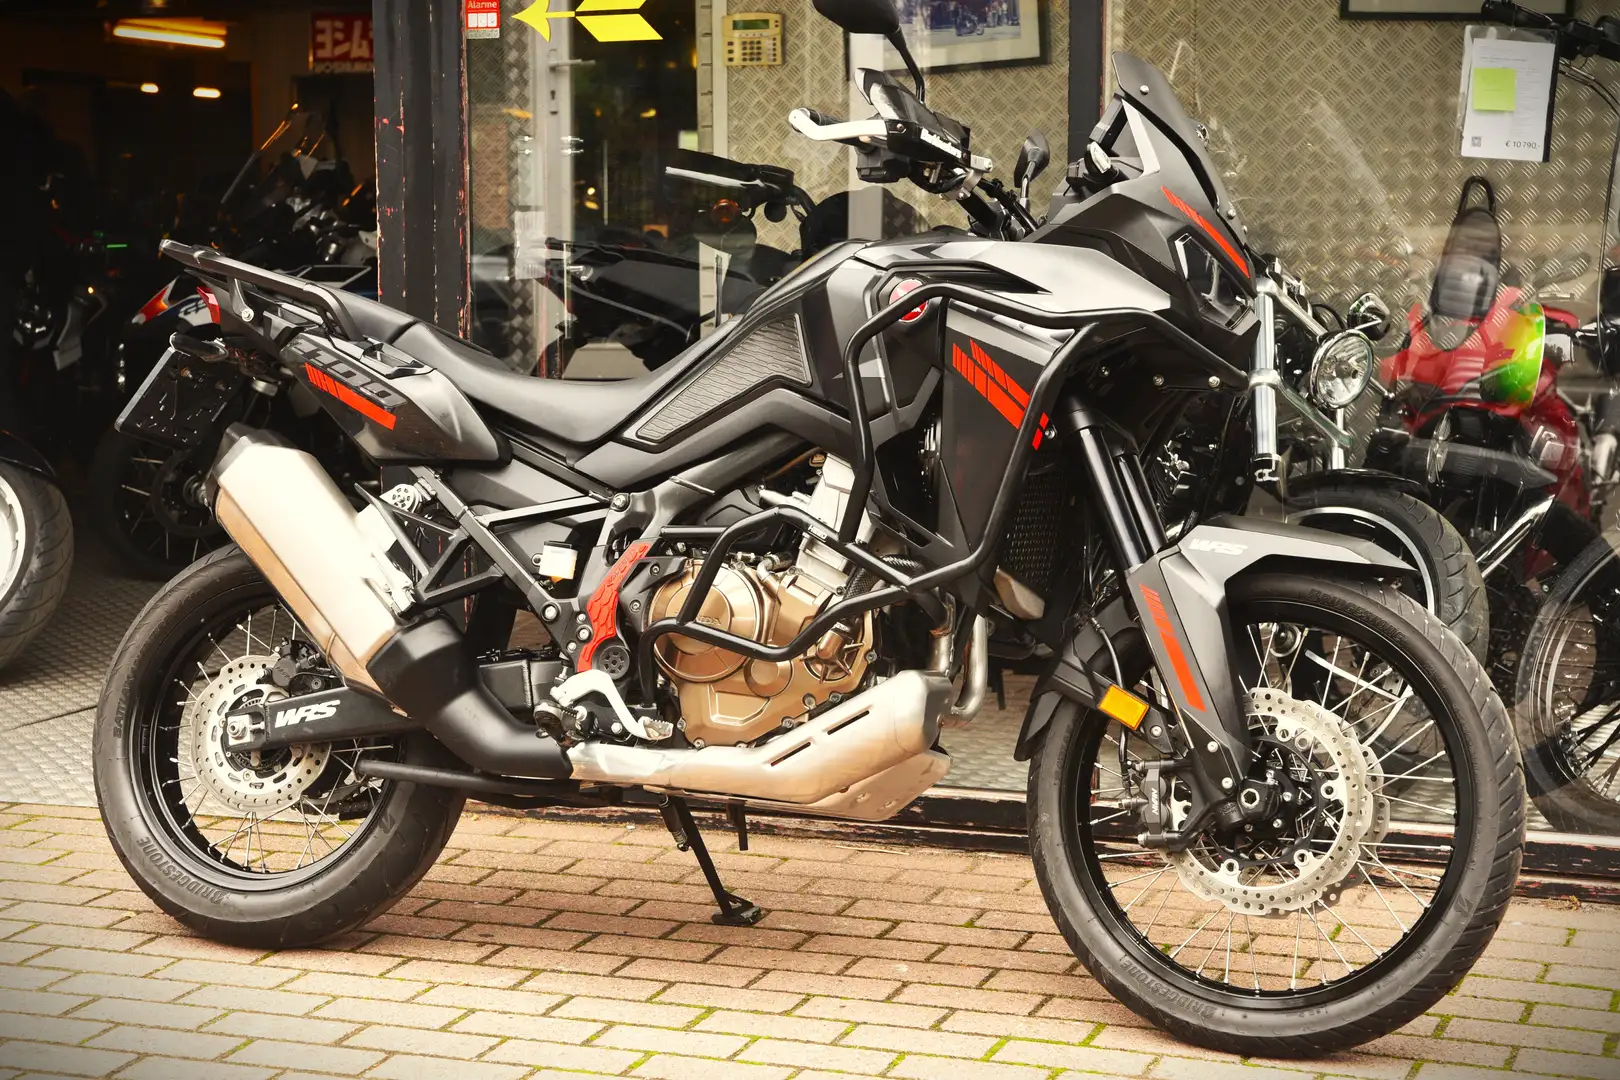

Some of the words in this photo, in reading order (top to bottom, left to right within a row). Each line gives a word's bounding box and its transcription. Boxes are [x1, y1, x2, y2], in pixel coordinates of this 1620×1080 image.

[468, 1, 497, 9] Alarme
[316, 20, 373, 58] ヨシム
[1188, 538, 1248, 555] WRS
[275, 700, 340, 728] WRS
[137, 836, 228, 904] BRIDGESTONE
[1120, 959, 1218, 1019] BRIDGESTONE
